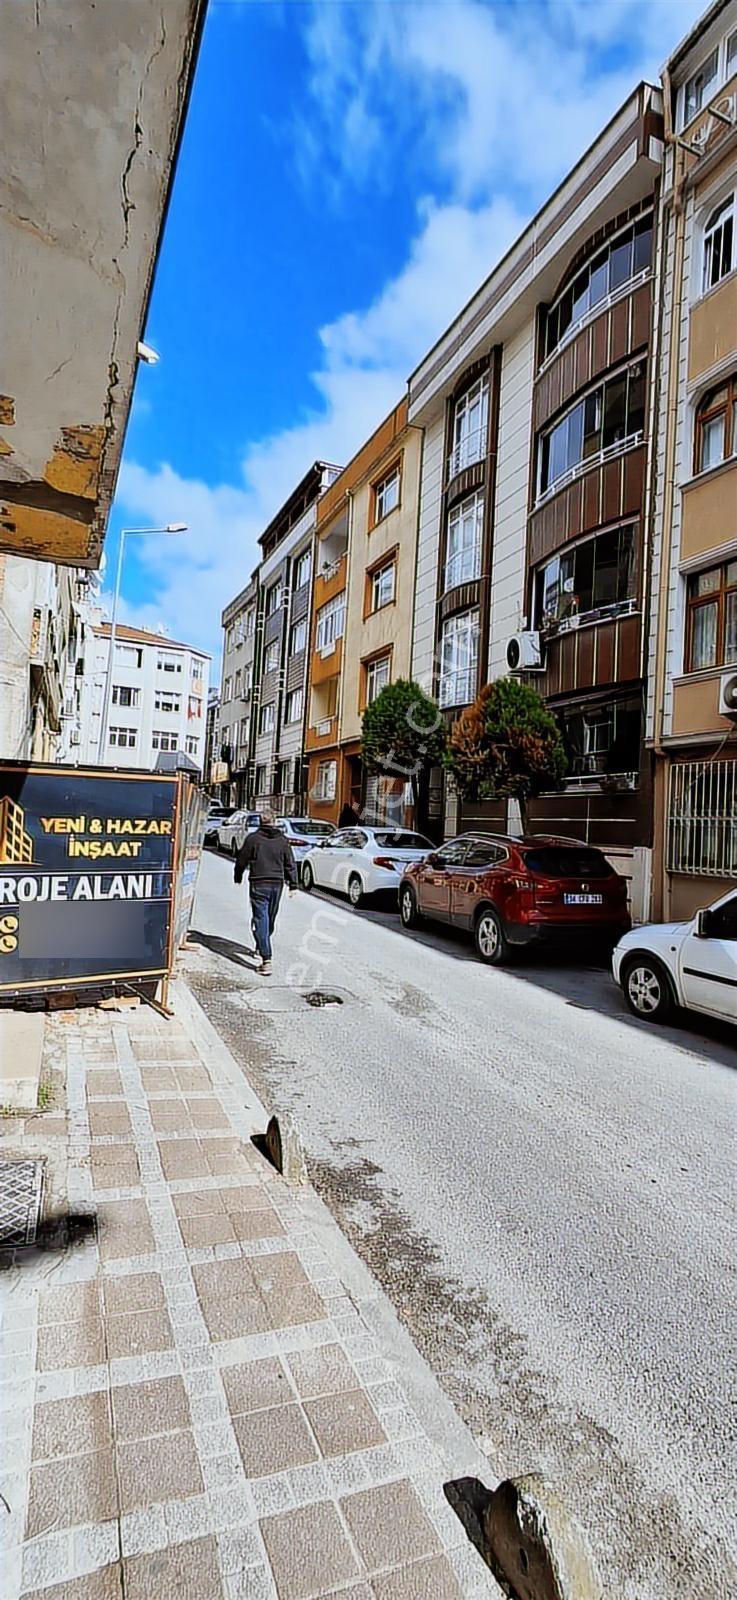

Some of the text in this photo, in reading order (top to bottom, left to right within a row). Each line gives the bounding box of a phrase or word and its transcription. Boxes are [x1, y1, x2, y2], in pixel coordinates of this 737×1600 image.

[41, 816, 172, 835] YENİ & HAZAR
[69, 834, 141, 859] İNŞAAT
[73, 875, 153, 900] ALANI
